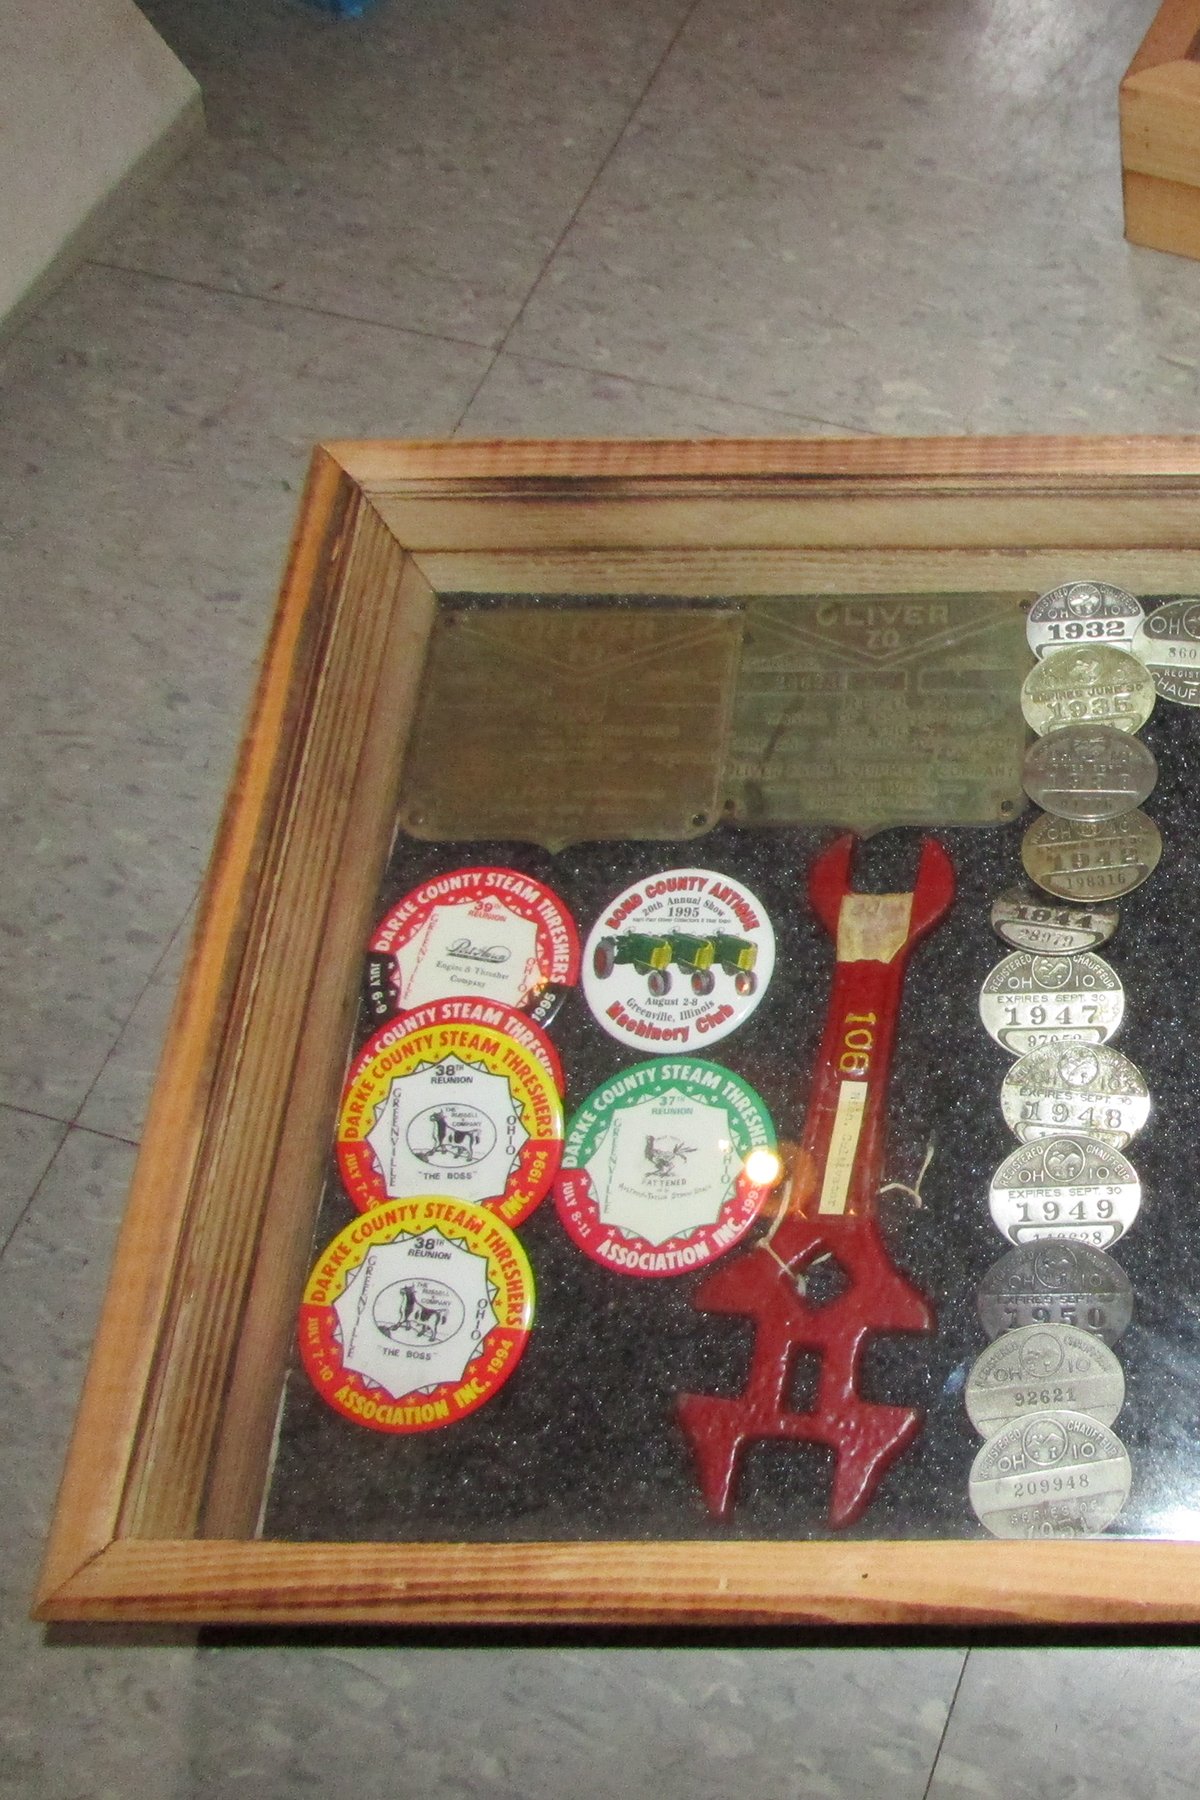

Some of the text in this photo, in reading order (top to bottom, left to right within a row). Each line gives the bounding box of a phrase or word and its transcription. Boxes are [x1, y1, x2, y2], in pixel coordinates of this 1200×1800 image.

[815, 603, 950, 628] OLIVER
[1048, 620, 1125, 640] 1932
[1067, 873, 1126, 890] 198316
[467, 909, 507, 922] REUNION
[605, 876, 761, 932] BOND COUNTY ANTIQUE
[642, 897, 725, 918] 20th Annual Show
[667, 907, 700, 918] 1995
[1014, 902, 1093, 928] 1944
[375, 873, 570, 984] DARKE COUNTY STEAM THRESHERS
[370, 963, 381, 987] JULY
[436, 960, 465, 972] Engine
[989, 954, 1115, 992] REGISTERED CHAUFFEUR
[449, 975, 486, 989] Company
[532, 993, 556, 1022] 1995
[626, 997, 715, 1022] Greenville, Illinois
[645, 997, 679, 1006] August
[997, 994, 1106, 1003] EXPIRES SEPT. 30
[375, 1003, 504, 1052] COUNTY STEAM
[606, 1001, 735, 1043] Machinery Club
[1004, 1005, 1098, 1026] 1947
[838, 1012, 878, 1073] 106
[431, 1076, 473, 1085] REUNION
[435, 1064, 465, 1076] 38TH
[345, 1030, 553, 1139] DARKE COUNTY STEAM THRESHERS
[1019, 1087, 1073, 1100] EXPIRES
[562, 1064, 722, 1168] DARKE COUNTY STEAM
[651, 1107, 693, 1115] REUNION
[1020, 1102, 1122, 1129] 1948
[505, 1115, 517, 1155] OHIO
[345, 1153, 361, 1179] JULY
[999, 1144, 1130, 1187] REGISTERED CHAUFFEUR
[499, 1151, 548, 1219] INC. 1994
[1008, 1186, 1122, 1199] EXPIRES SEPT. 30
[562, 1181, 591, 1238] JULY 8-11
[1016, 1199, 1114, 1222] 1949
[407, 1249, 452, 1260] REUNION
[414, 1237, 445, 1250] 38TH
[596, 1240, 711, 1271] ASSOCIATION
[712, 1217, 748, 1248] INC.
[311, 1202, 524, 1325] DARKE COUNTY STEAM THRESHERS
[470, 1299, 488, 1341] OHIO
[1003, 1306, 1106, 1329] 1950
[308, 1317, 334, 1381] JULY 7-10
[334, 1339, 515, 1424] ASSOCIATION INC. 1994
[1014, 1388, 1076, 1407] 92621
[980, 1420, 1118, 1479] REGISTERED CHAUFFEUR
[1014, 1474, 1089, 1498] 209948
[1011, 1501, 1098, 1524] SERIES OF
